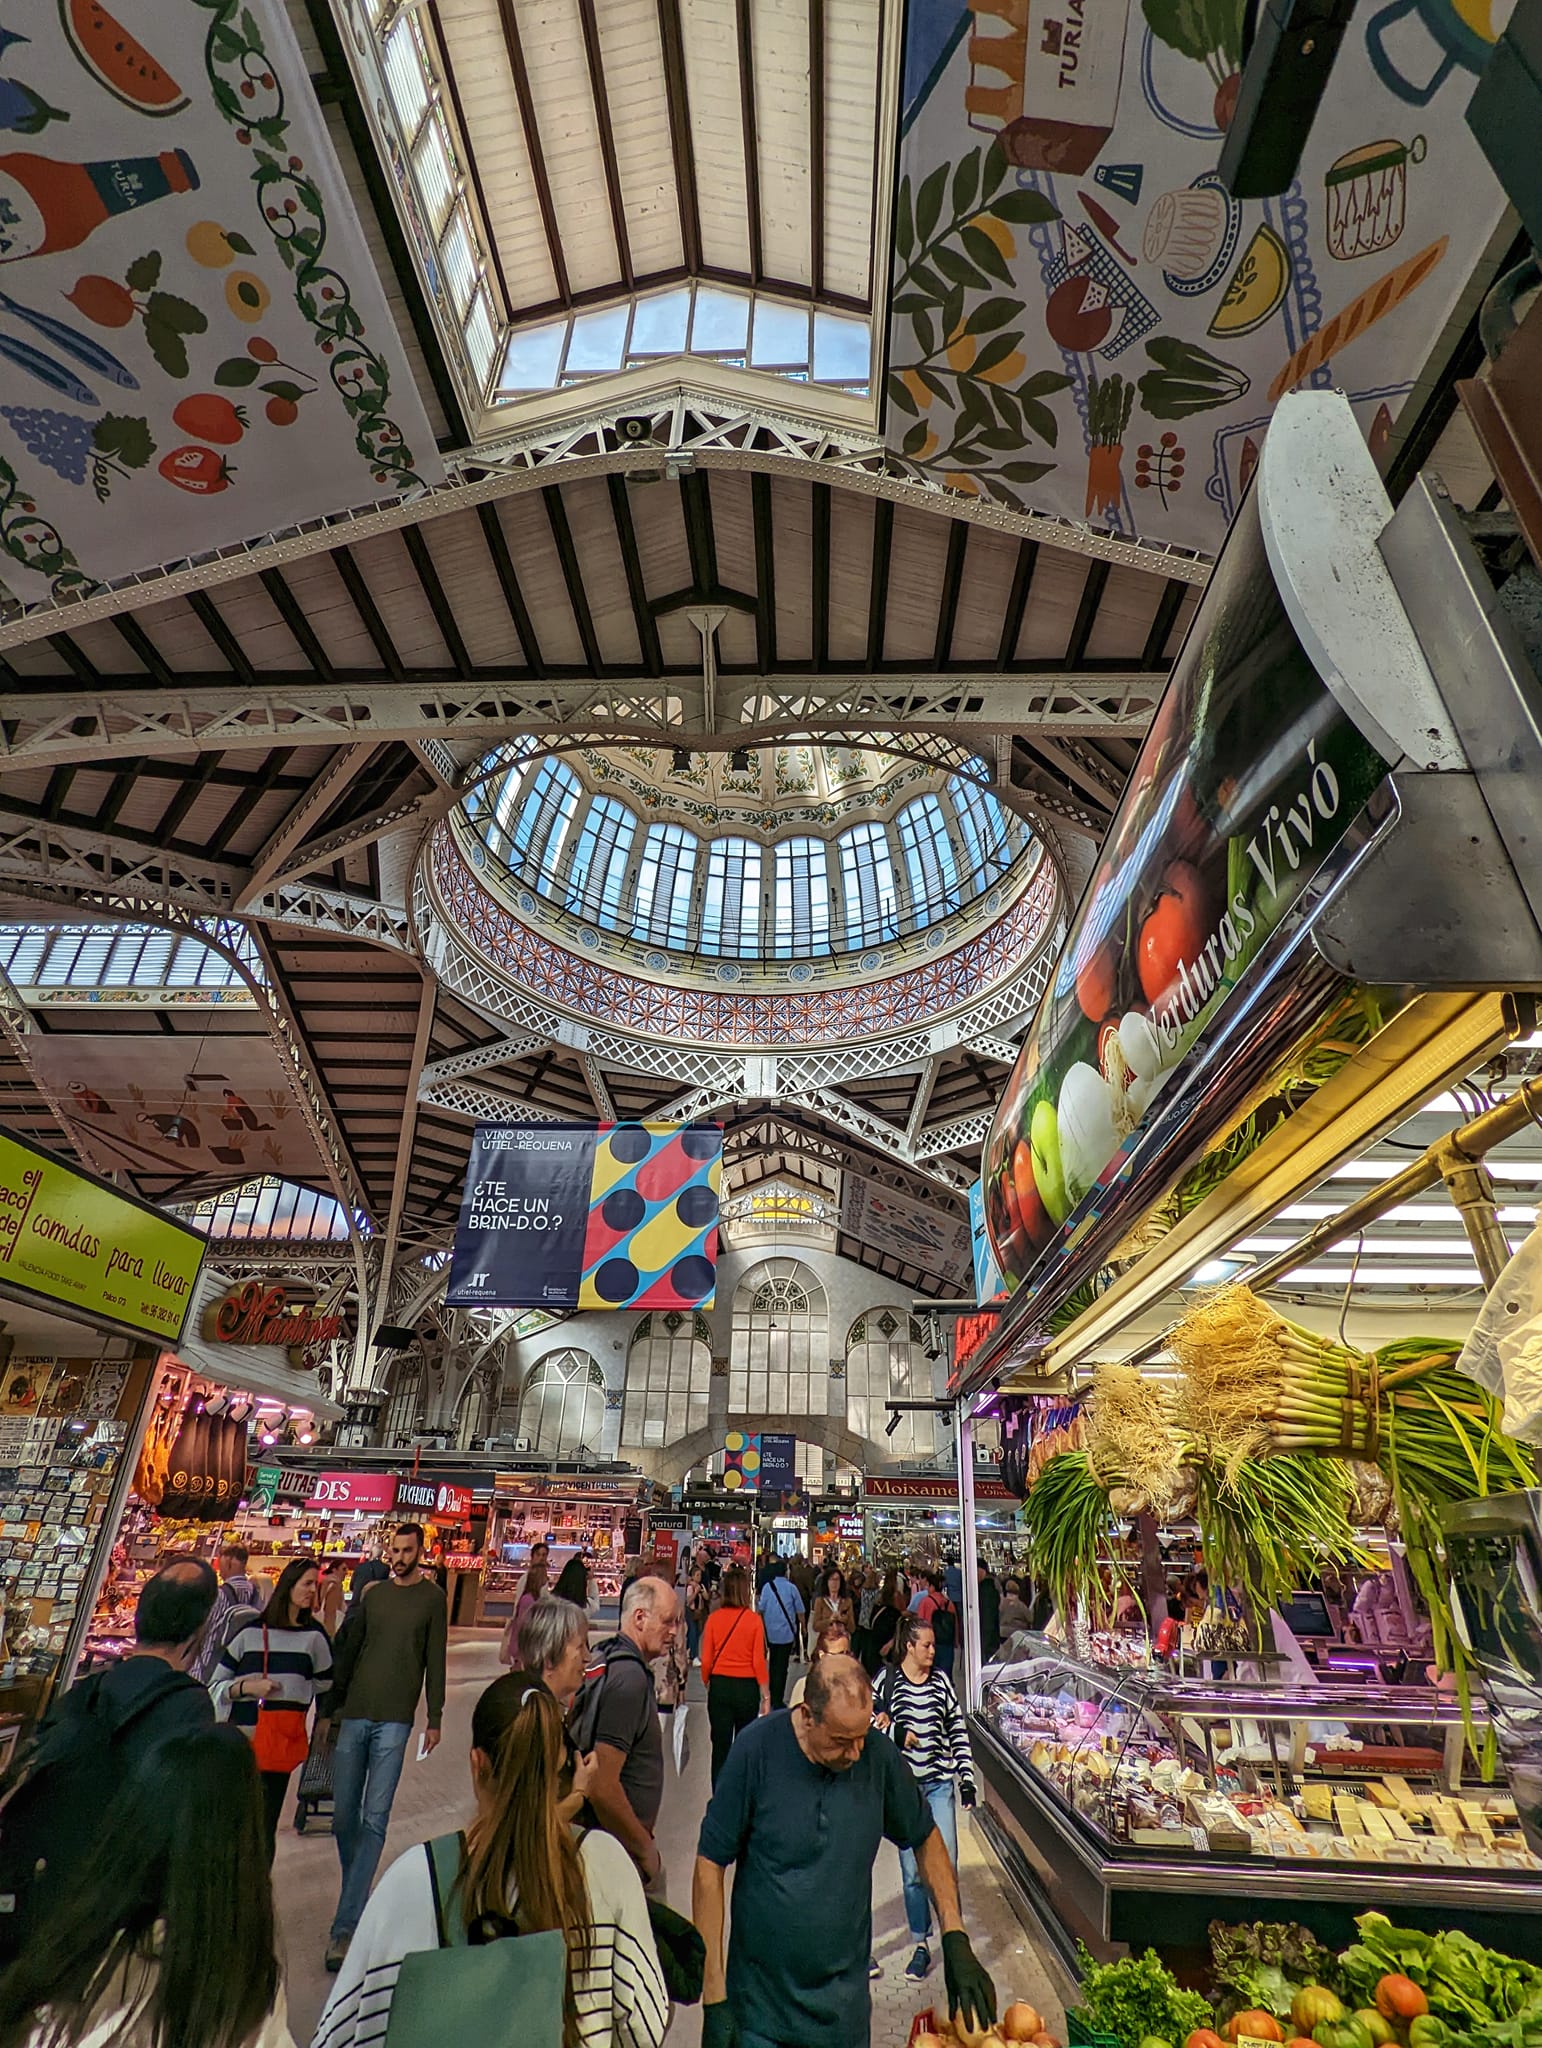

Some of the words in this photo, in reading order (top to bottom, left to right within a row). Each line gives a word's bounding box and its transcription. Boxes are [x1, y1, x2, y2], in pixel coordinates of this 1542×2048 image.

[1059, 0, 1085, 88] TURIA
[111, 162, 137, 206] TURIA
[1246, 737, 1340, 899] Vivó
[1142, 889, 1255, 1066] Verduras
[482, 1140, 573, 1151] UTIEL-REQUENA
[484, 1130, 514, 1140] VINO
[516, 1131, 535, 1140] DO
[0, 1185, 28, 1210] acó
[474, 1181, 507, 1196] ¿TE
[471, 1198, 521, 1213] HACE
[523, 1198, 549, 1213] UN
[32, 1213, 100, 1258] comidas
[104, 1247, 145, 1279] para
[152, 1260, 190, 1297] llevar
[277, 1470, 316, 1494] RUTAS
[309, 1480, 351, 1500] DES
[651, 1521, 683, 1529] natura
